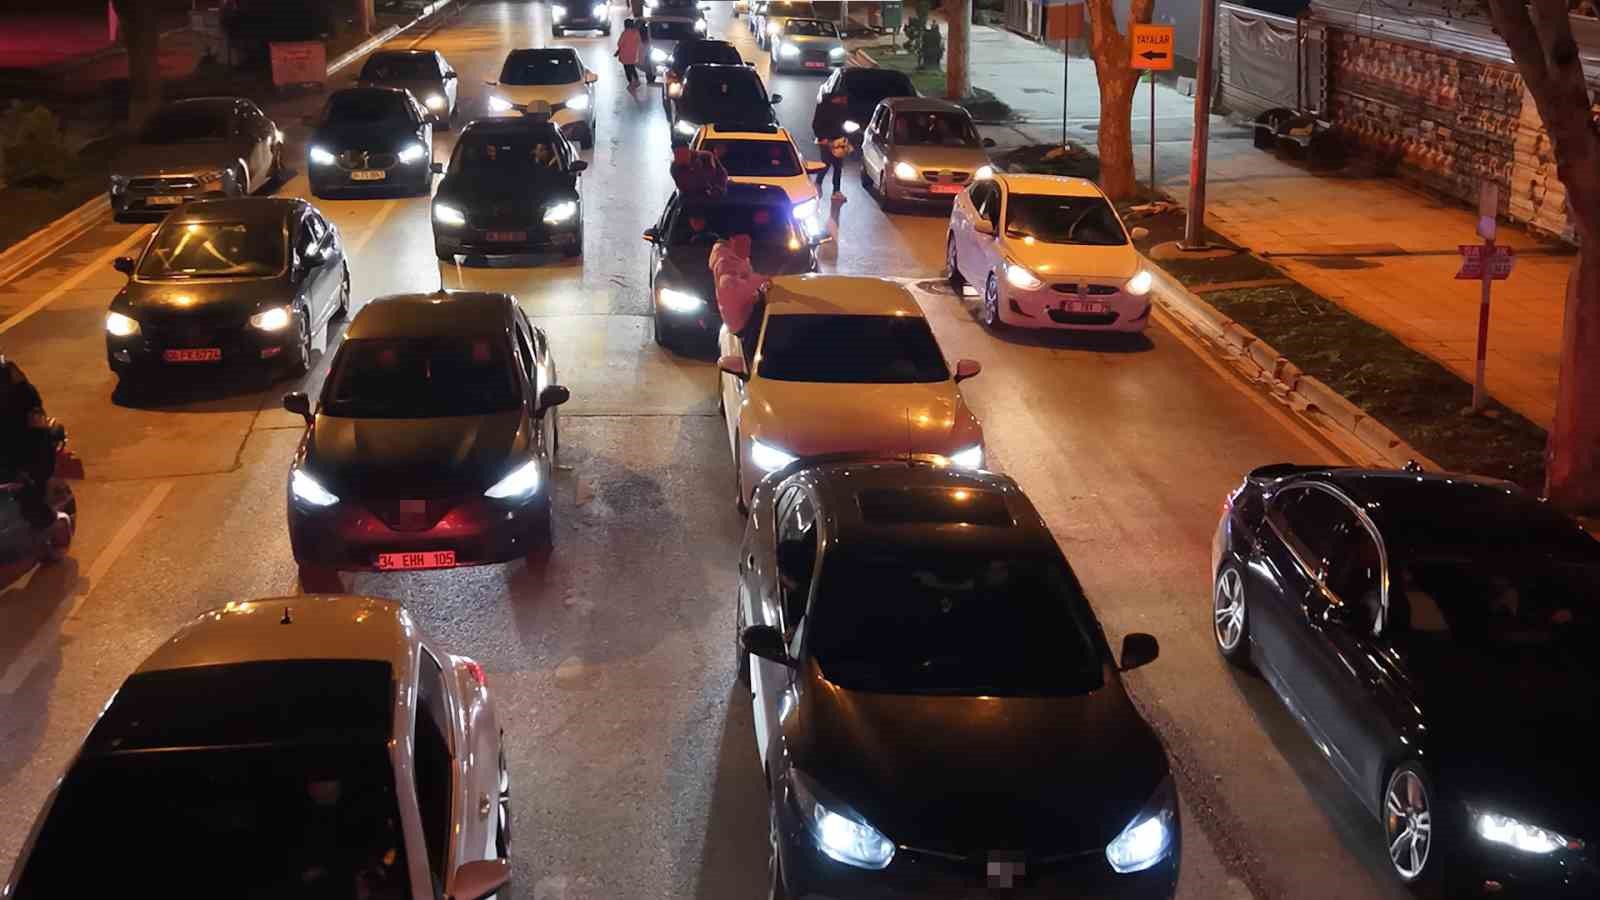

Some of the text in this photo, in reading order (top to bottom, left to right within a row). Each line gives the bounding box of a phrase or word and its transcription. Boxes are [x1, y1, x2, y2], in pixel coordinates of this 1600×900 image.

[1136, 34, 1170, 45] YAYALAR
[379, 552, 454, 568] 34 EHH 105
